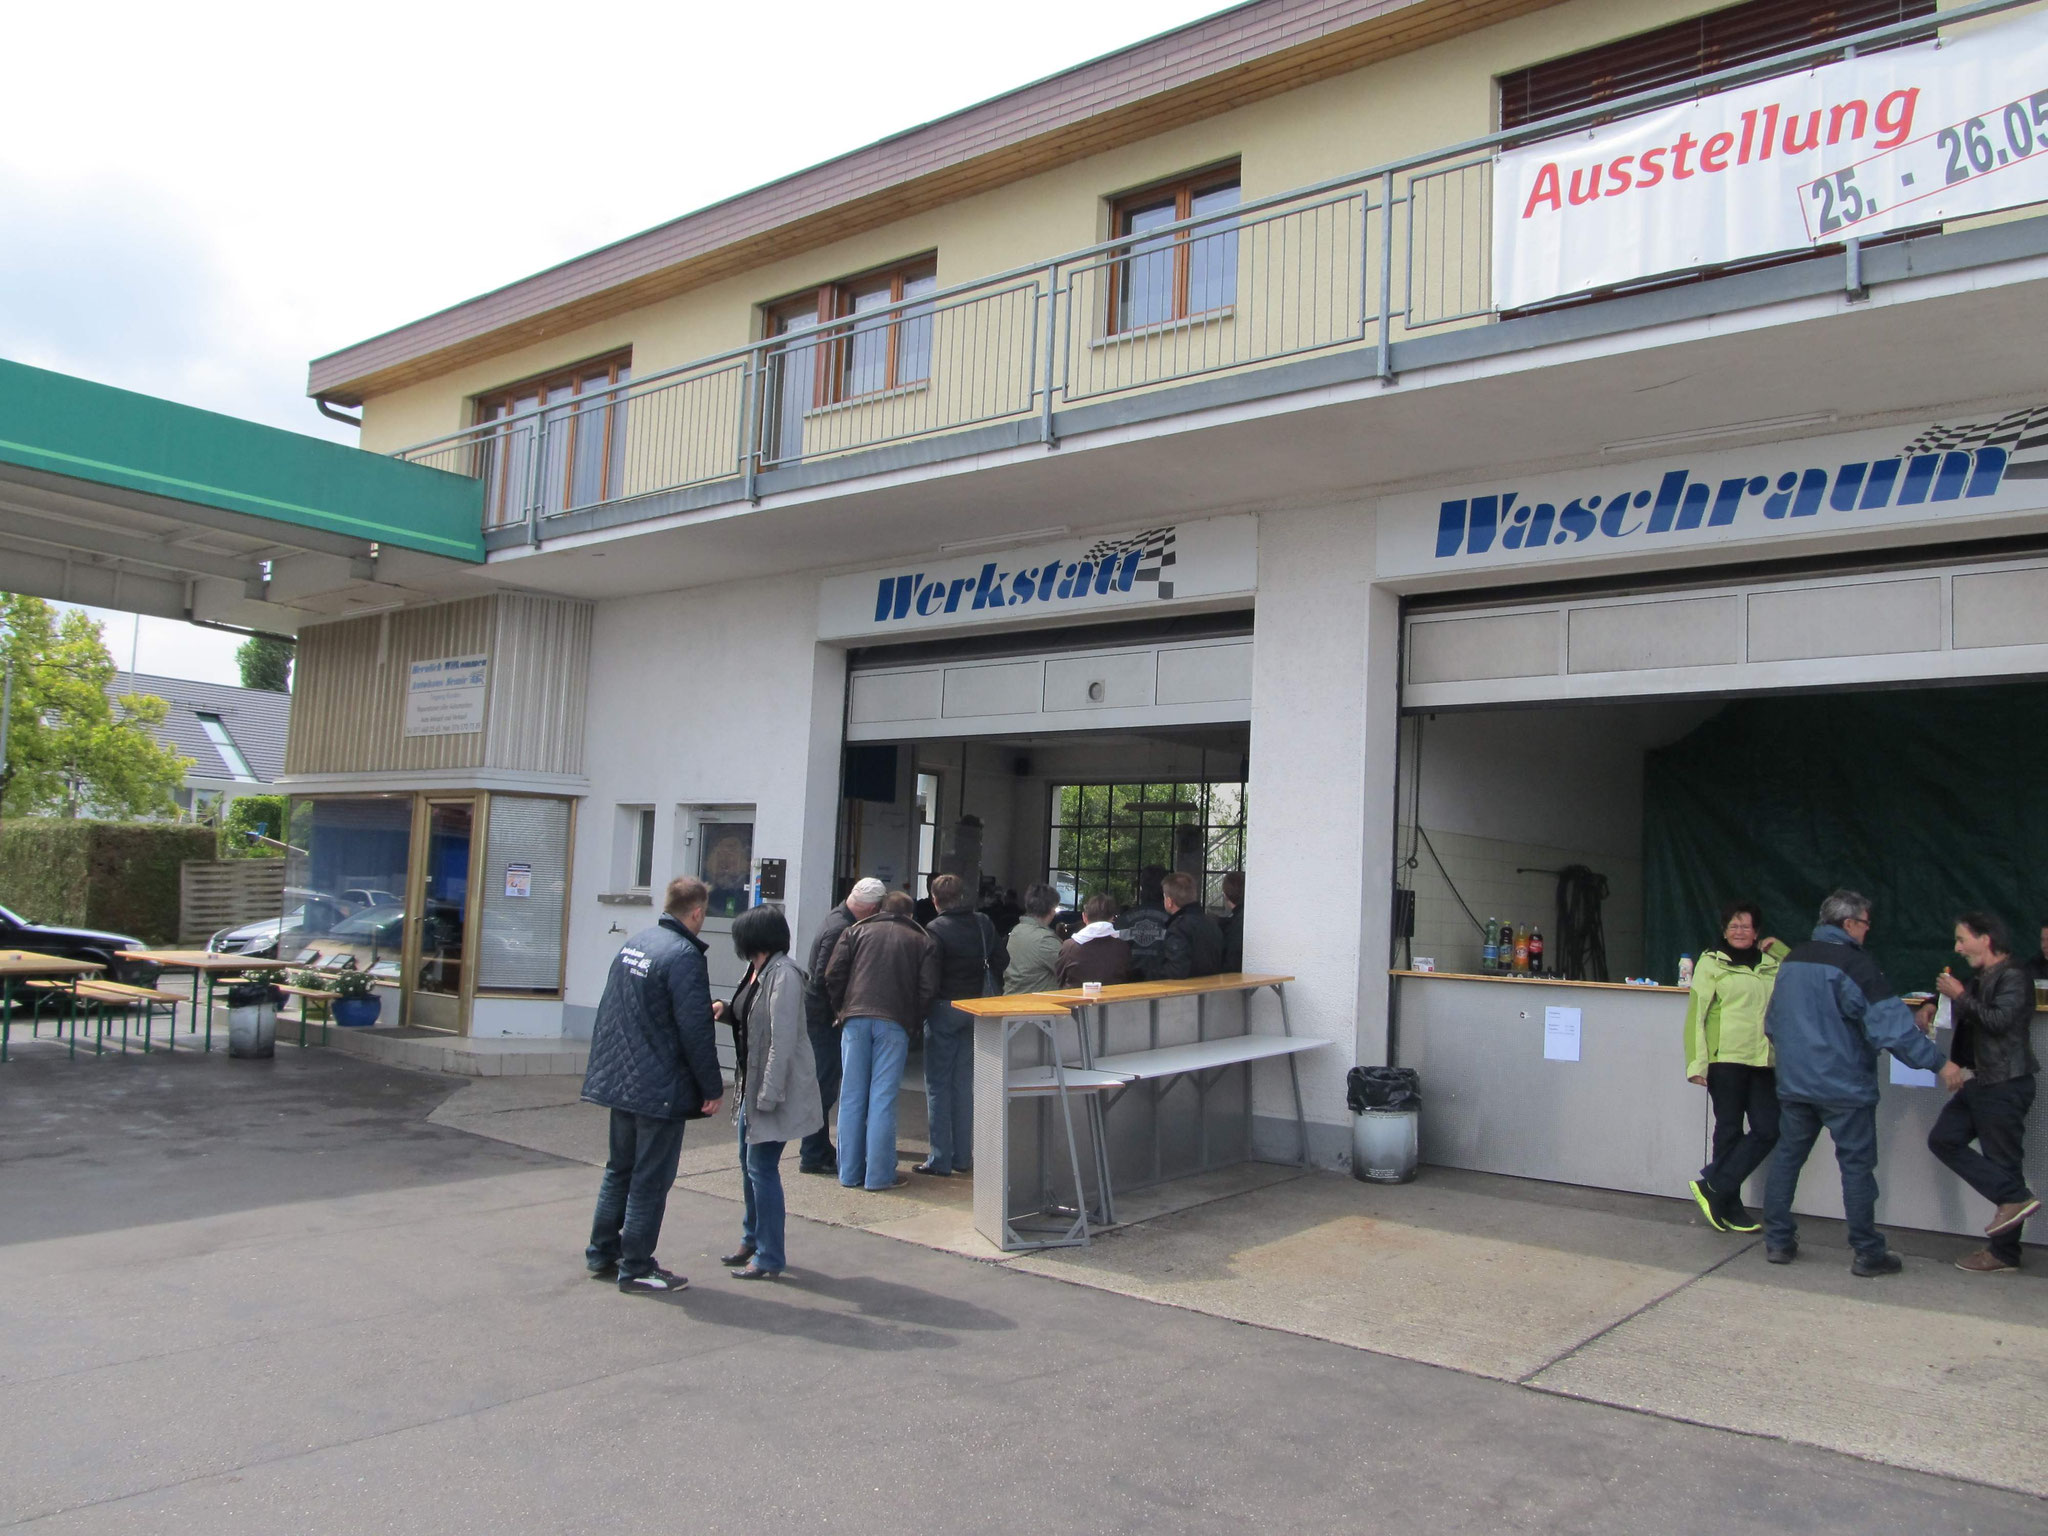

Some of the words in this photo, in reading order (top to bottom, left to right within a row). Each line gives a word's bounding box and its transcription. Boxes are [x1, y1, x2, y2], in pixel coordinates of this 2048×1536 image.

[1522, 87, 1921, 219] Ausstellung
[1812, 166, 1877, 234] 25.
[1435, 447, 2010, 558] Waschraum
[874, 548, 1146, 622] Werkstatt
